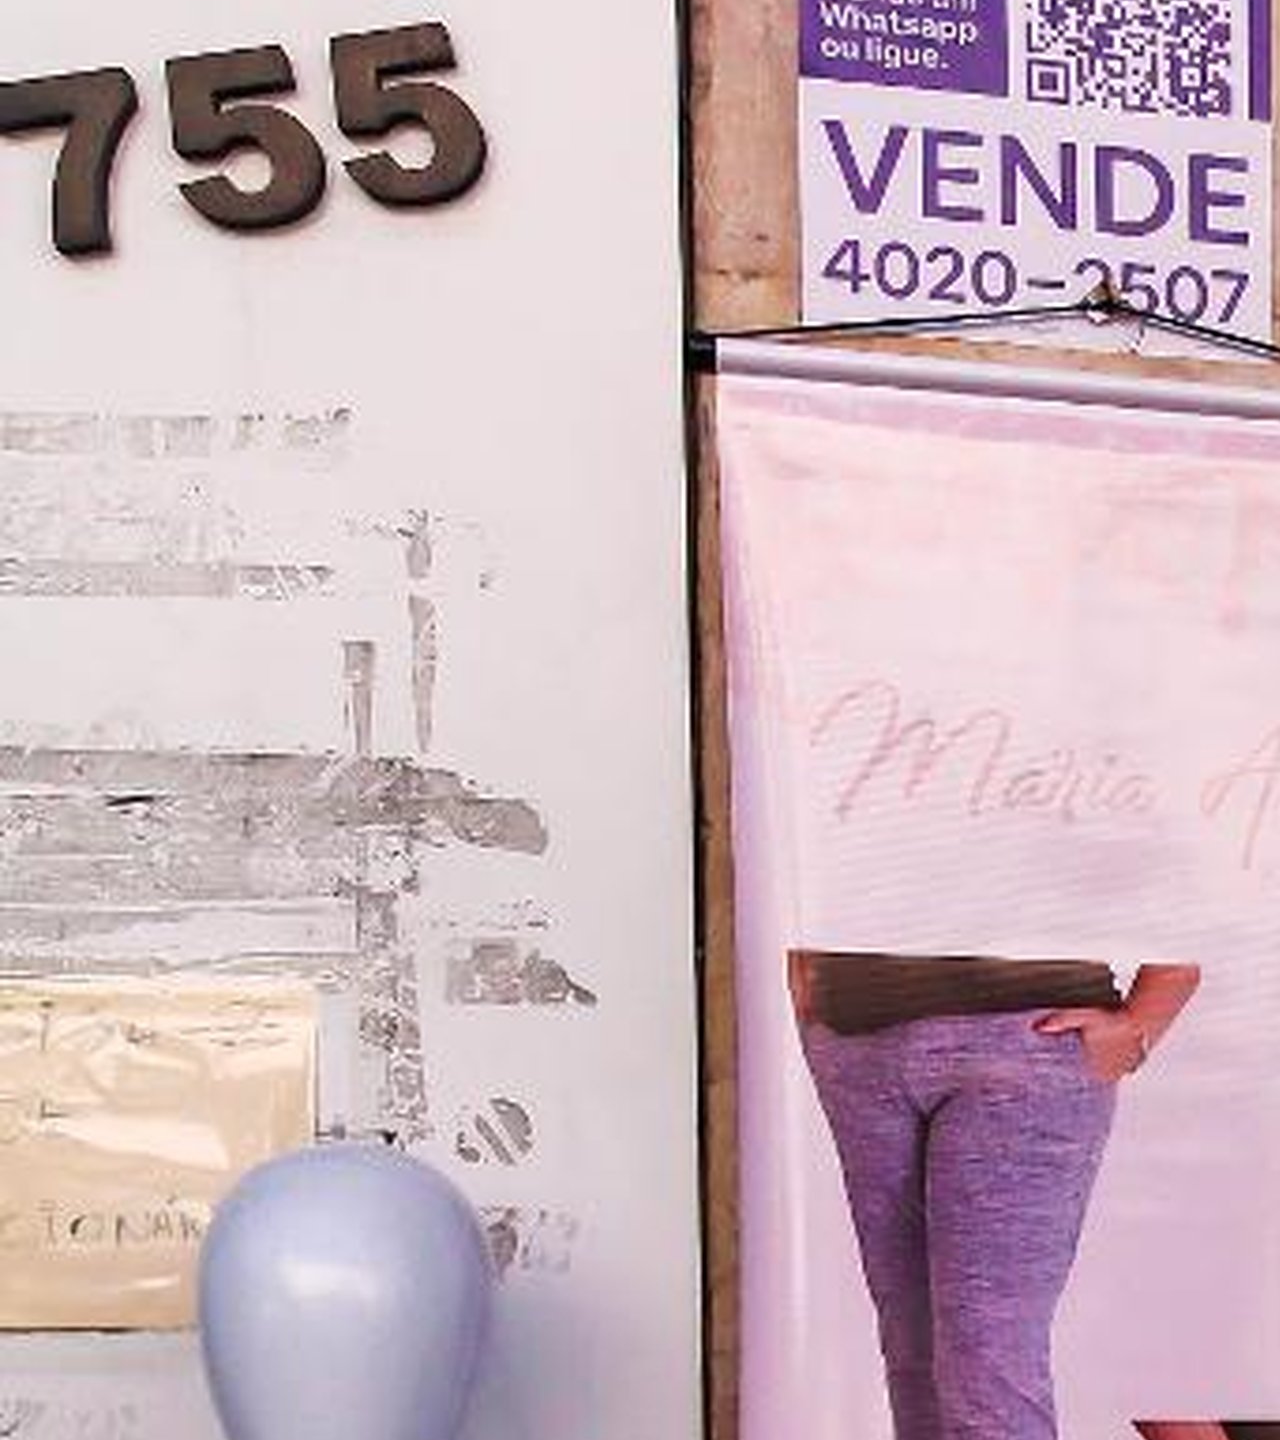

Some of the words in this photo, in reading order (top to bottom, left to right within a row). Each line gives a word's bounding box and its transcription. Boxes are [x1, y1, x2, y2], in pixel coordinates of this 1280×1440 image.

[819, 0, 978, 45] Whatsapp
[820, 38, 860, 61] ou
[0, 22, 487, 259] 755
[822, 119, 1250, 246] VENDE
[810, 679, 1157, 823] Maria
